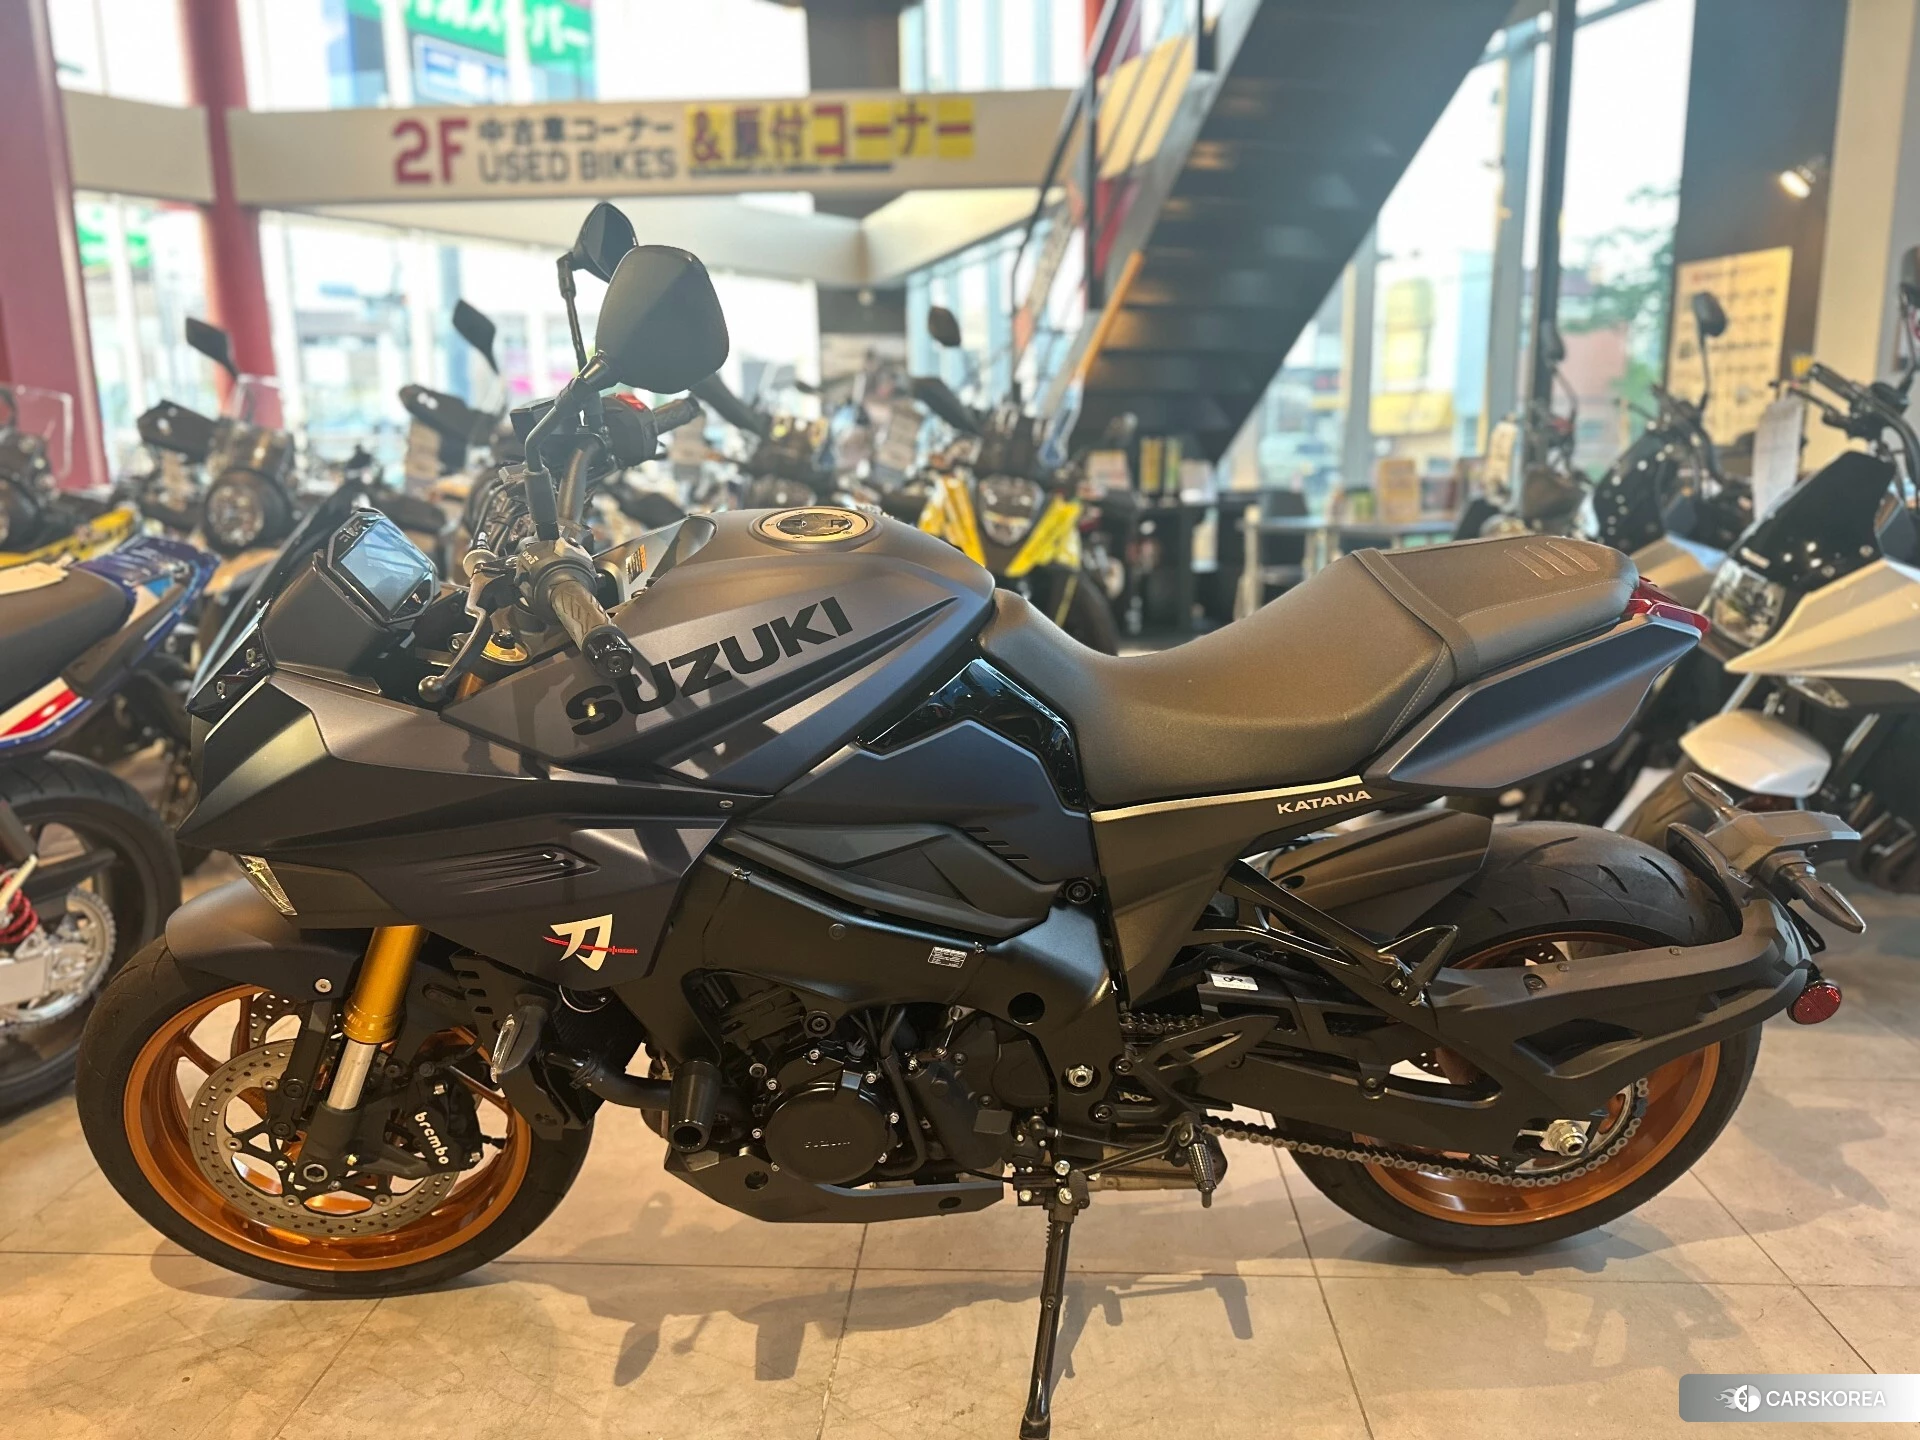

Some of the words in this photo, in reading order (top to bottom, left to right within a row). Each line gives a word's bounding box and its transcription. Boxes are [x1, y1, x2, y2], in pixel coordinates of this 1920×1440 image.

[393, 117, 469, 184] 2F
[478, 151, 569, 183] USED
[580, 147, 677, 181] BIKES
[565, 596, 853, 736] SUZUKI
[1276, 790, 1372, 815] KATANA
[549, 913, 613, 971] 刀
[414, 1111, 449, 1164] brembo
